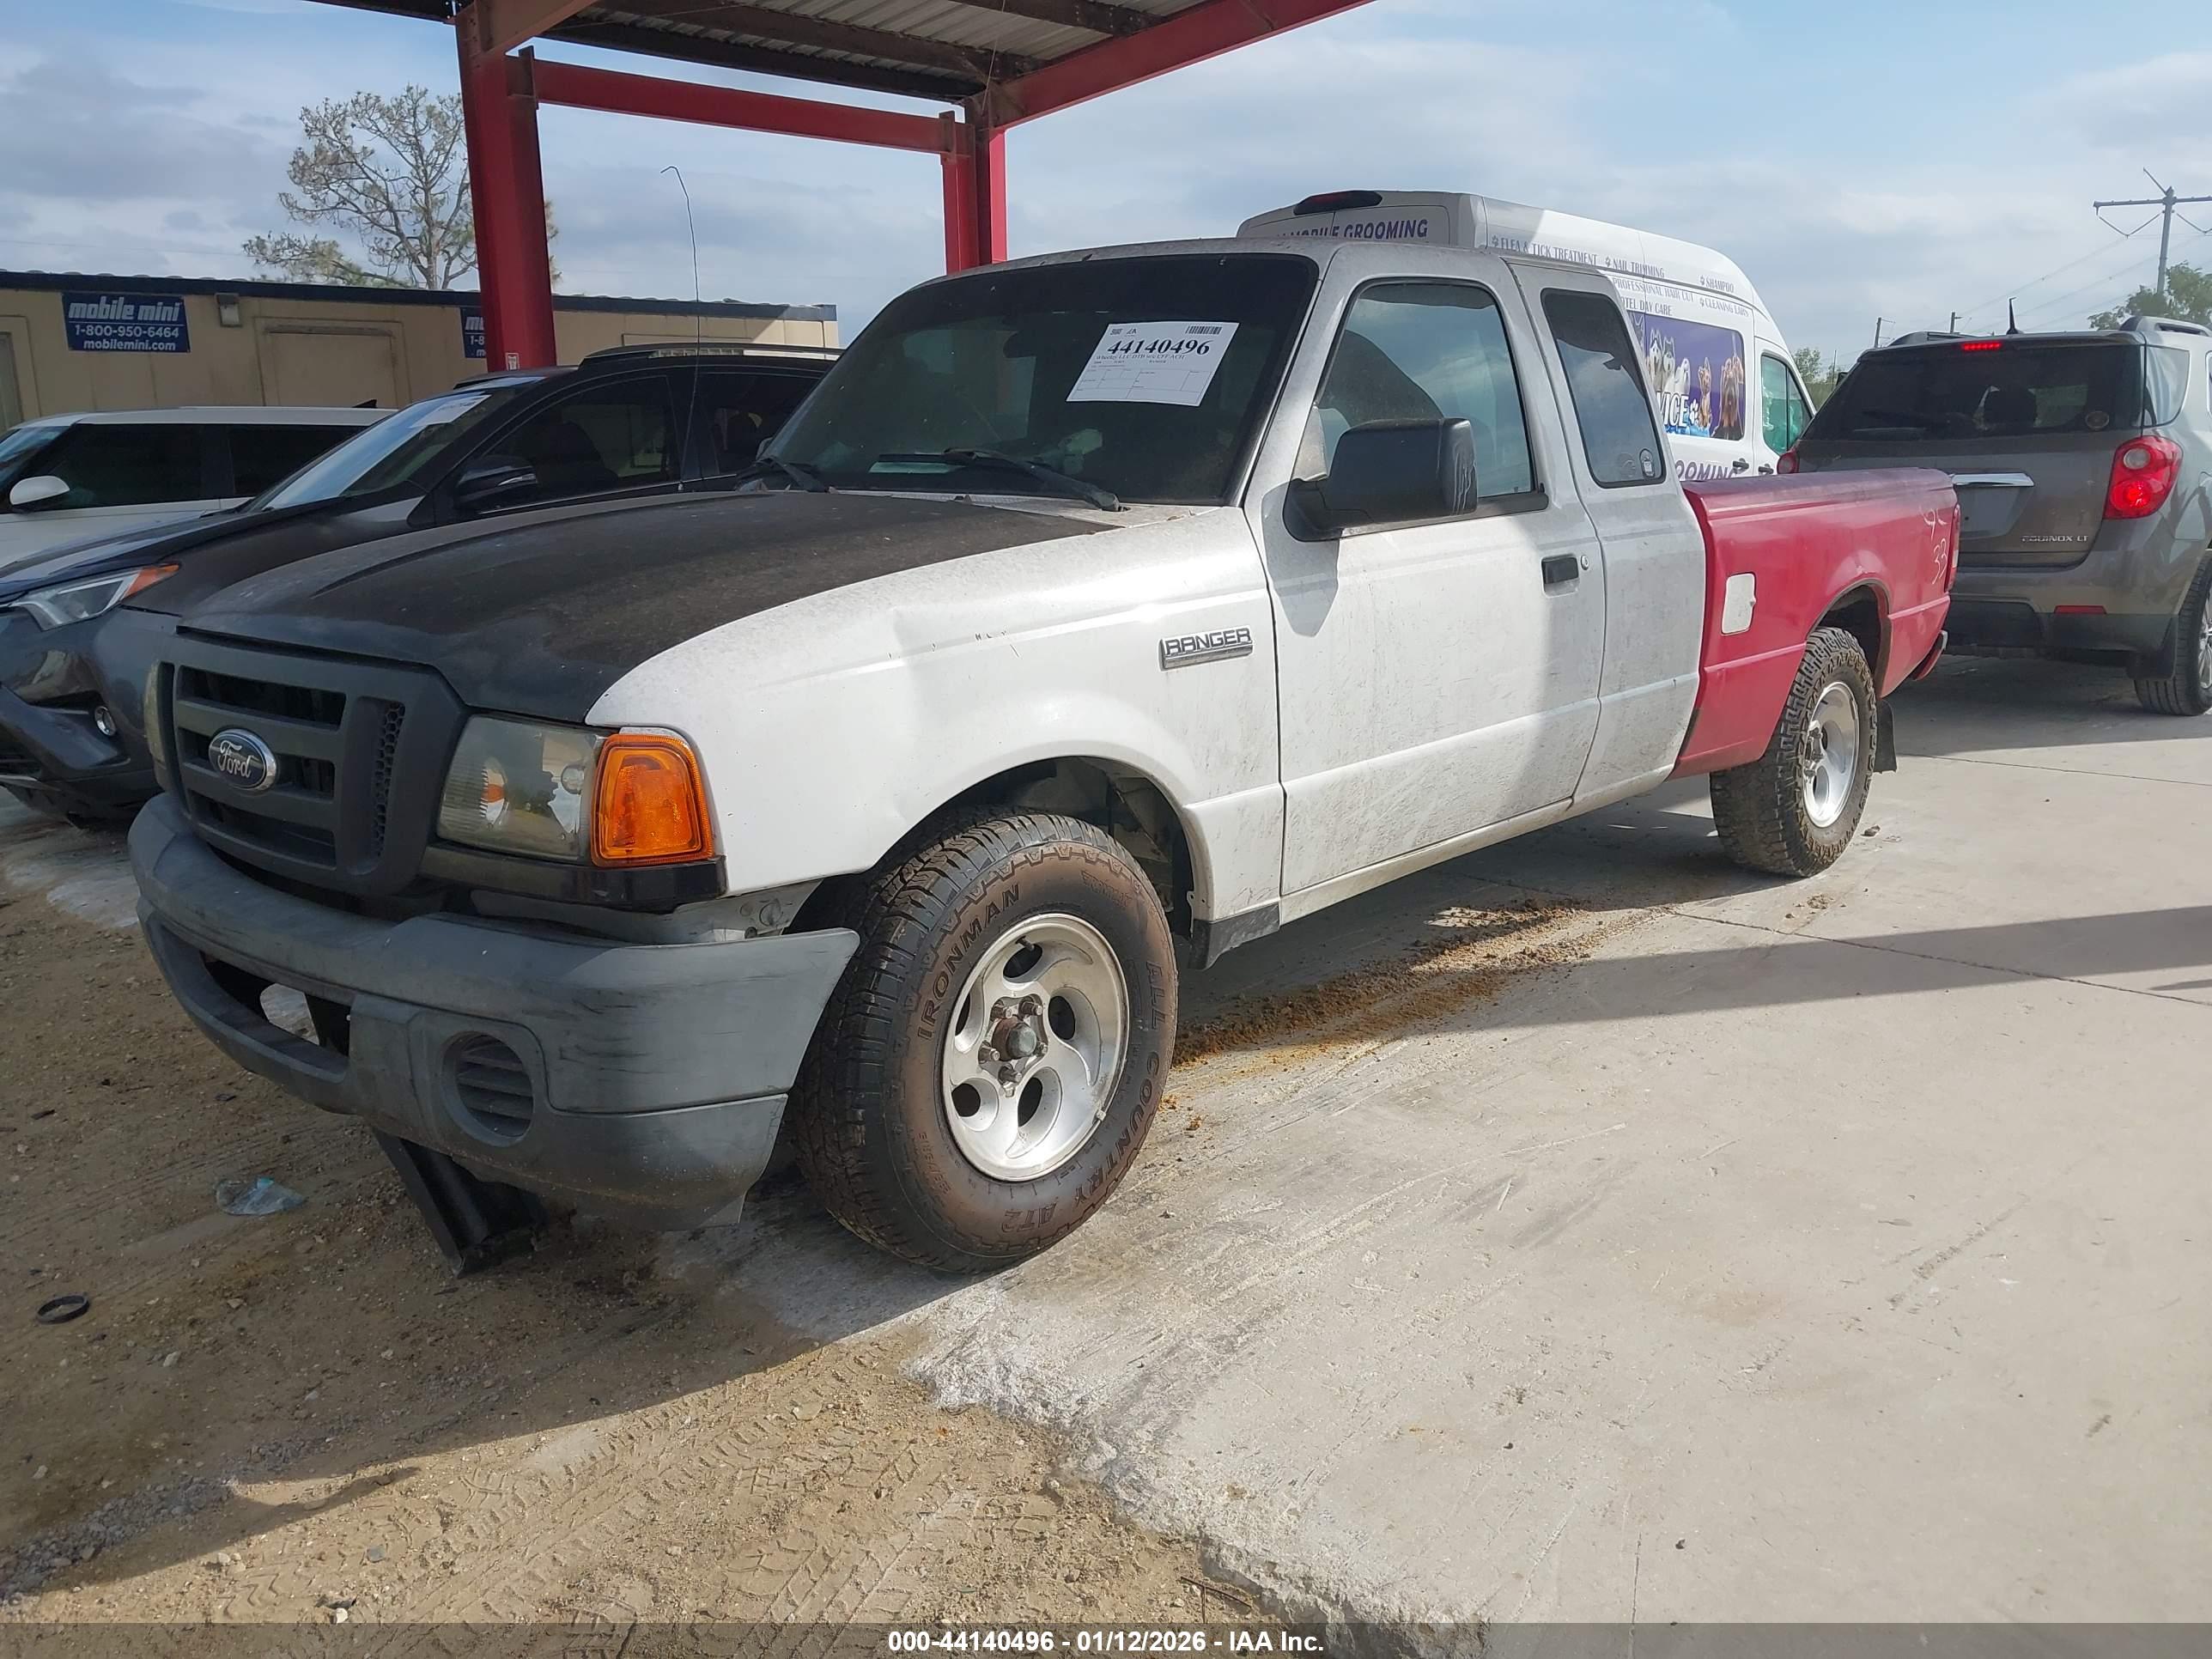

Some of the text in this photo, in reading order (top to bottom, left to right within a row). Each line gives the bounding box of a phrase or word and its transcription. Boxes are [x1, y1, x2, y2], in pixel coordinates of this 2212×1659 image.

[1344, 219, 1428, 240] GROOMING
[1532, 243, 1551, 258] TICK
[1553, 246, 1597, 264] TREATMENT
[1613, 258, 1664, 277] NAIL TRIMMING
[1612, 277, 1663, 296] PROFESSIONAL
[1705, 279, 1735, 293] SHAMPOO
[68, 295, 181, 321] mobile mini
[1639, 300, 1654, 312] DAY
[1655, 302, 1673, 316] CARE
[75, 325, 179, 337] 1-800-950-6464
[83, 338, 176, 350] mobilemini.com
[1107, 338, 1213, 355] 44140496
[1165, 628, 1251, 655] RANGER
[217, 740, 252, 778] Ford
[917, 884, 1020, 1041] IRONMAN
[1147, 961, 1166, 1030] ALL
[1075, 1051, 1160, 1206] COUNTRY
